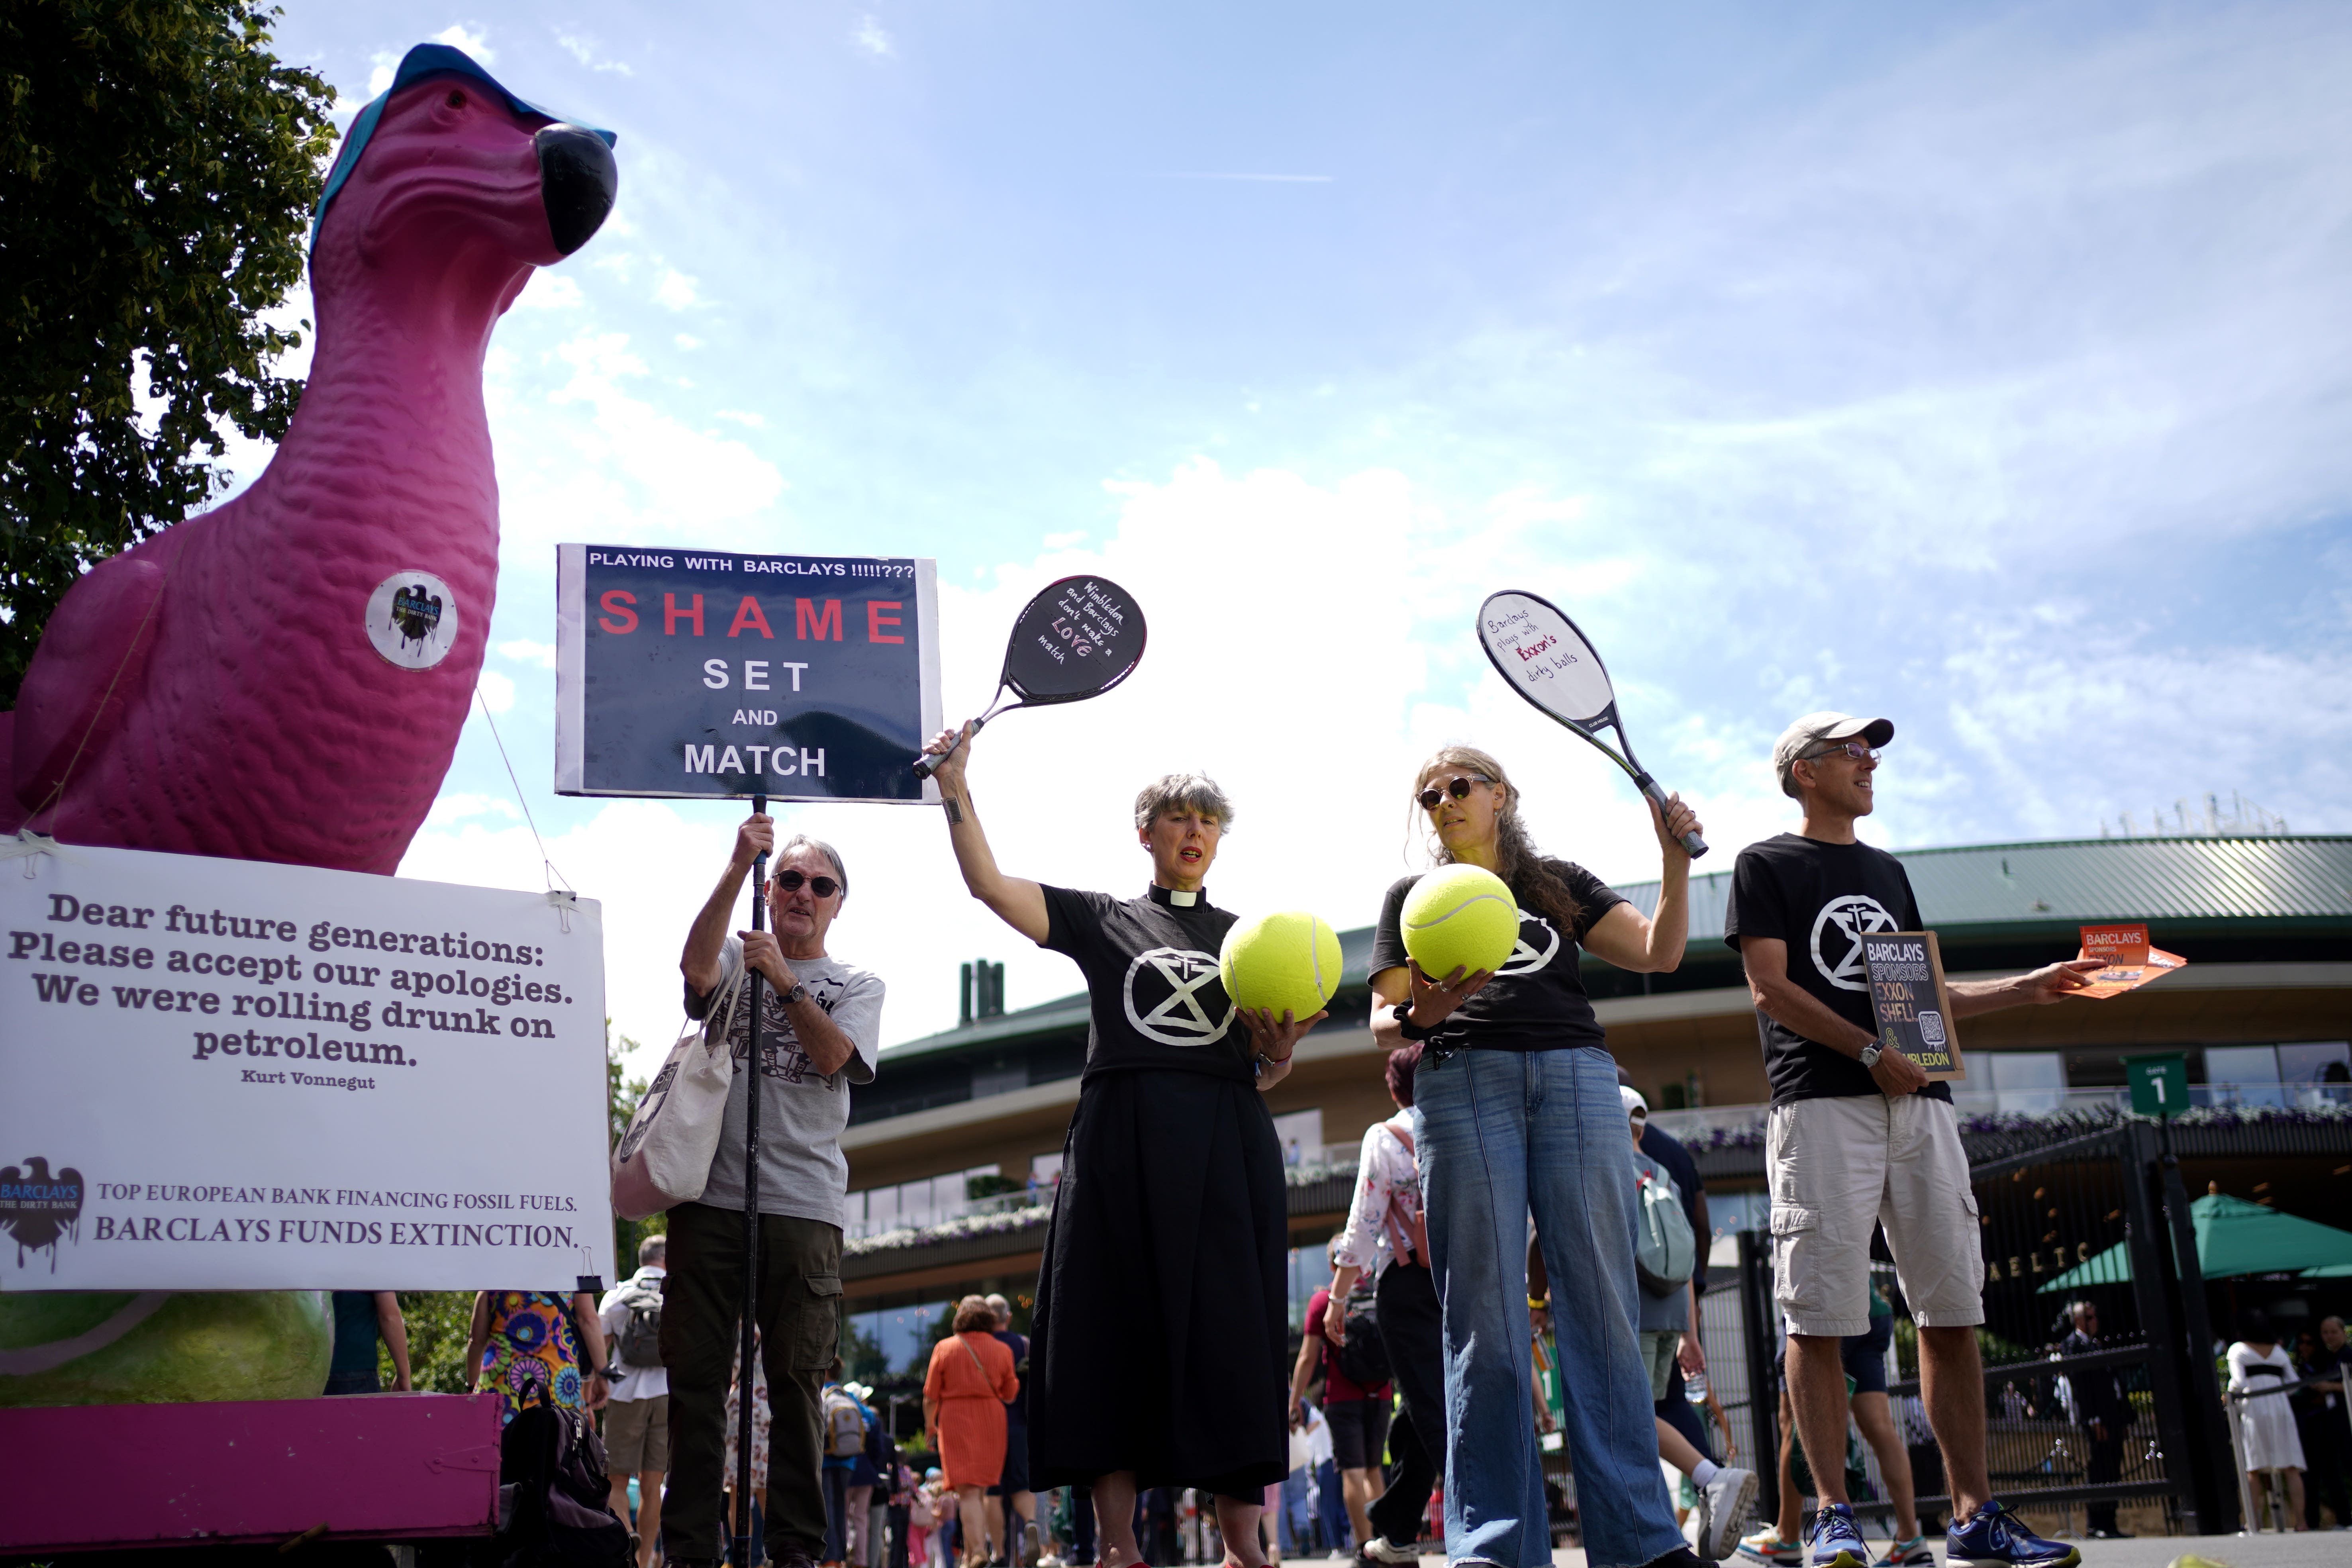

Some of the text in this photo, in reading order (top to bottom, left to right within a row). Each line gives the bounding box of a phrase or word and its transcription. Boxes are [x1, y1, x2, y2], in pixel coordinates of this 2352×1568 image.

[590, 553, 914, 578] PLAYING WITH BARCLAYS !!!!!???
[398, 597, 438, 615] BARCLAYS
[598, 590, 905, 645] SHAME
[1066, 588, 1119, 637] and Barclays
[1084, 582, 1123, 625] Wimbledon
[1058, 599, 1113, 657] don't make a
[1488, 610, 1529, 634] Barclays
[1037, 634, 1065, 665] match
[1051, 617, 1092, 657] LOVE
[1497, 623, 1539, 653] plays with
[703, 658, 809, 692] SET
[1526, 652, 1578, 682] dirty balls
[731, 709, 778, 726] AND
[685, 743, 825, 776] MATCH
[47, 893, 543, 967] Dear future generations:
[2085, 932, 2142, 945] BARCLAYS
[1867, 943, 1925, 962] BARCLAYS
[7, 931, 573, 1006] Please accept our apologies.
[1871, 963, 1929, 982] SPONSORS
[31, 973, 555, 1039] We were rolling drunk on
[1874, 982, 1915, 1001] EXXON
[1879, 1002, 1919, 1023] SHELL
[192, 1029, 417, 1067] petroleum.
[1886, 1027, 1899, 1049] &
[241, 1070, 375, 1092] Kurt Vonnegut
[2151, 1077, 2166, 1104] 1
[0, 1184, 78, 1199] BARCLAYS
[0, 1200, 17, 1209] THE
[51, 1201, 78, 1209] BANK
[97, 1183, 577, 1212] TOP EUROPEAN BANK FINANCING FOSSIL FUELS.
[93, 1216, 579, 1249] BARCLAYS FUNDS EXTINCTION.
